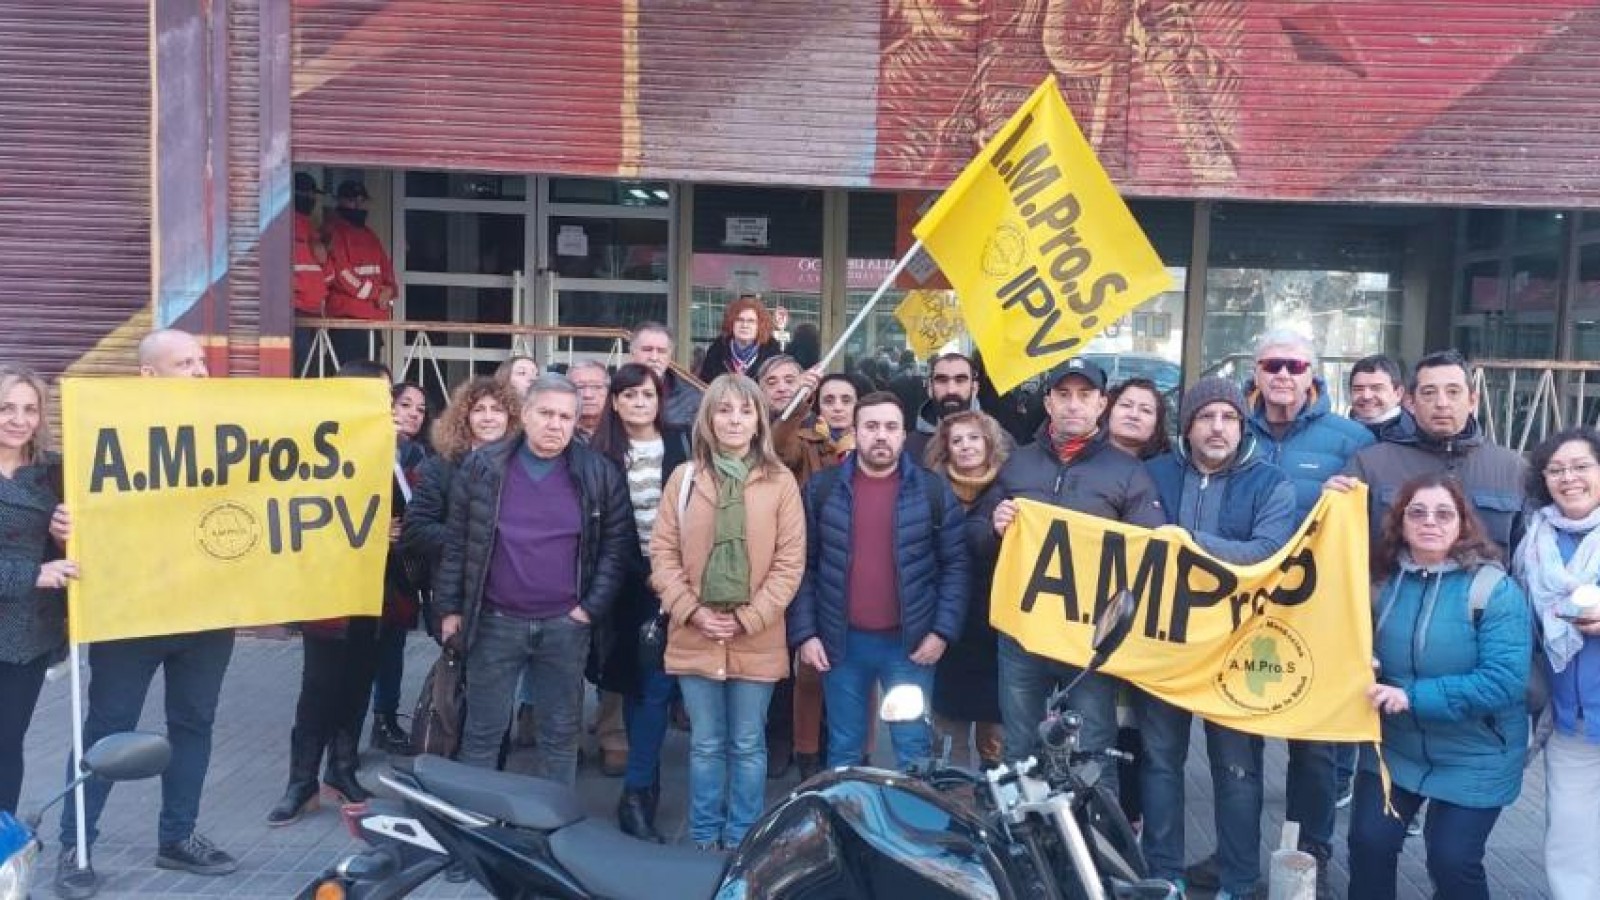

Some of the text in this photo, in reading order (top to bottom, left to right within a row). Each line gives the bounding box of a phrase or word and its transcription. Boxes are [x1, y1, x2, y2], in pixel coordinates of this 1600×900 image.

[996, 265, 1080, 358] IPV
[89, 421, 356, 493] A.M.Pro.S.
[266, 494, 381, 554] IPV
[1229, 660, 1296, 673] A.M.Pro.S
